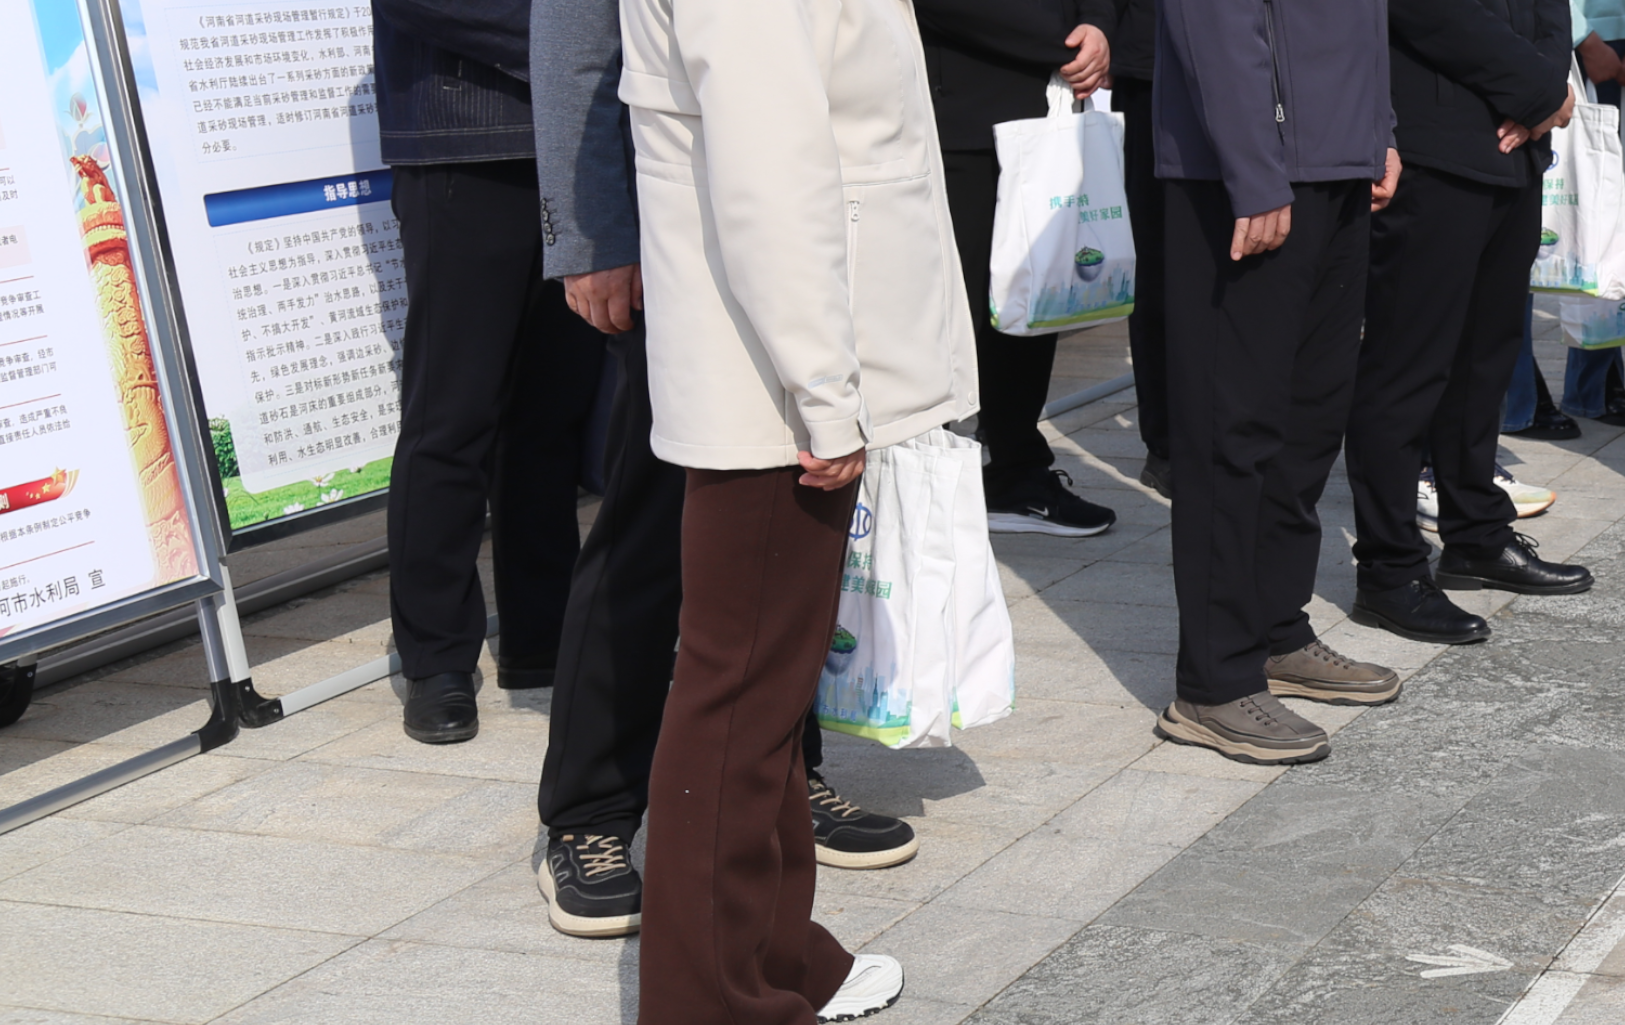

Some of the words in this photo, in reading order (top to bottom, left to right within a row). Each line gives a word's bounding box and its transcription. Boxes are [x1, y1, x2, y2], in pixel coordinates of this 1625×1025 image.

[184, 45, 374, 72] 社会经济发展和市场环境变化，水利部、河南
[202, 139, 238, 154] 分必要。
[0, 189, 18, 201] 及时
[323, 179, 372, 202] 指导思想
[1079, 205, 1123, 224] 美好家园
[0, 234, 18, 246] 者电
[237, 277, 407, 321] 统治理、两手发力”治水思路，以及关于
[0, 575, 30, 591] 起施行。
[88, 569, 106, 590] 宣
